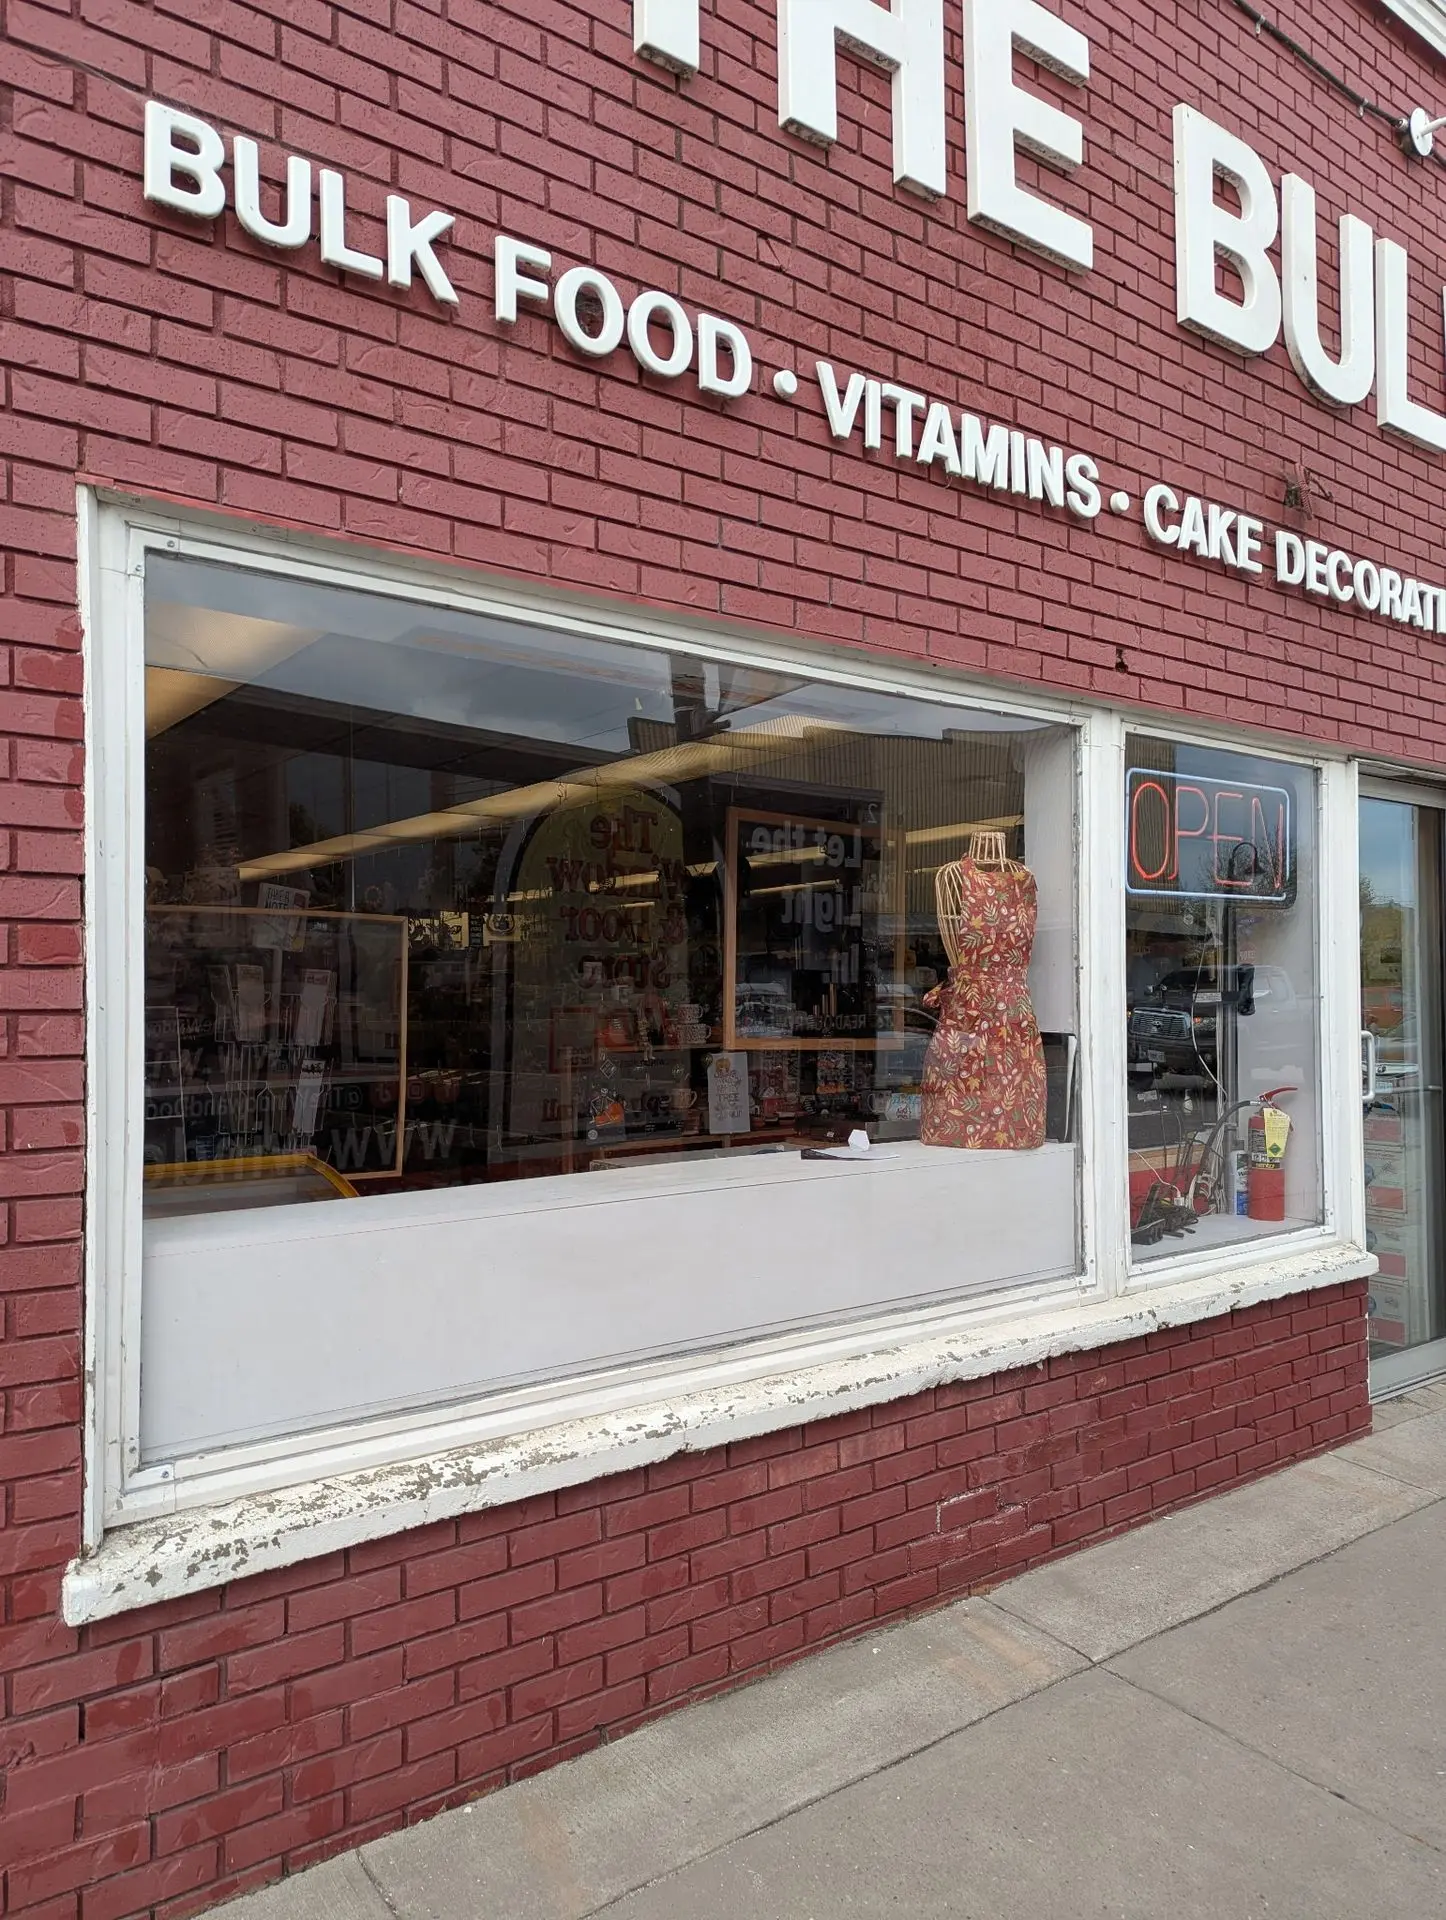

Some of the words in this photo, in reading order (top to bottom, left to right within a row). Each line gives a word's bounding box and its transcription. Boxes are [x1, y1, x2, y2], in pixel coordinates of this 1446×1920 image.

[144, 99, 459, 304] BULK
[494, 234, 753, 400] FOOD
[816, 361, 1101, 520] VITAMINS
[1143, 483, 1264, 574] CAKE
[1275, 530, 1446, 634] DECORATI
[633, 0, 1094, 275] HE
[1173, 103, 1446, 454] BUL
[1131, 781, 1286, 889] OPEN
